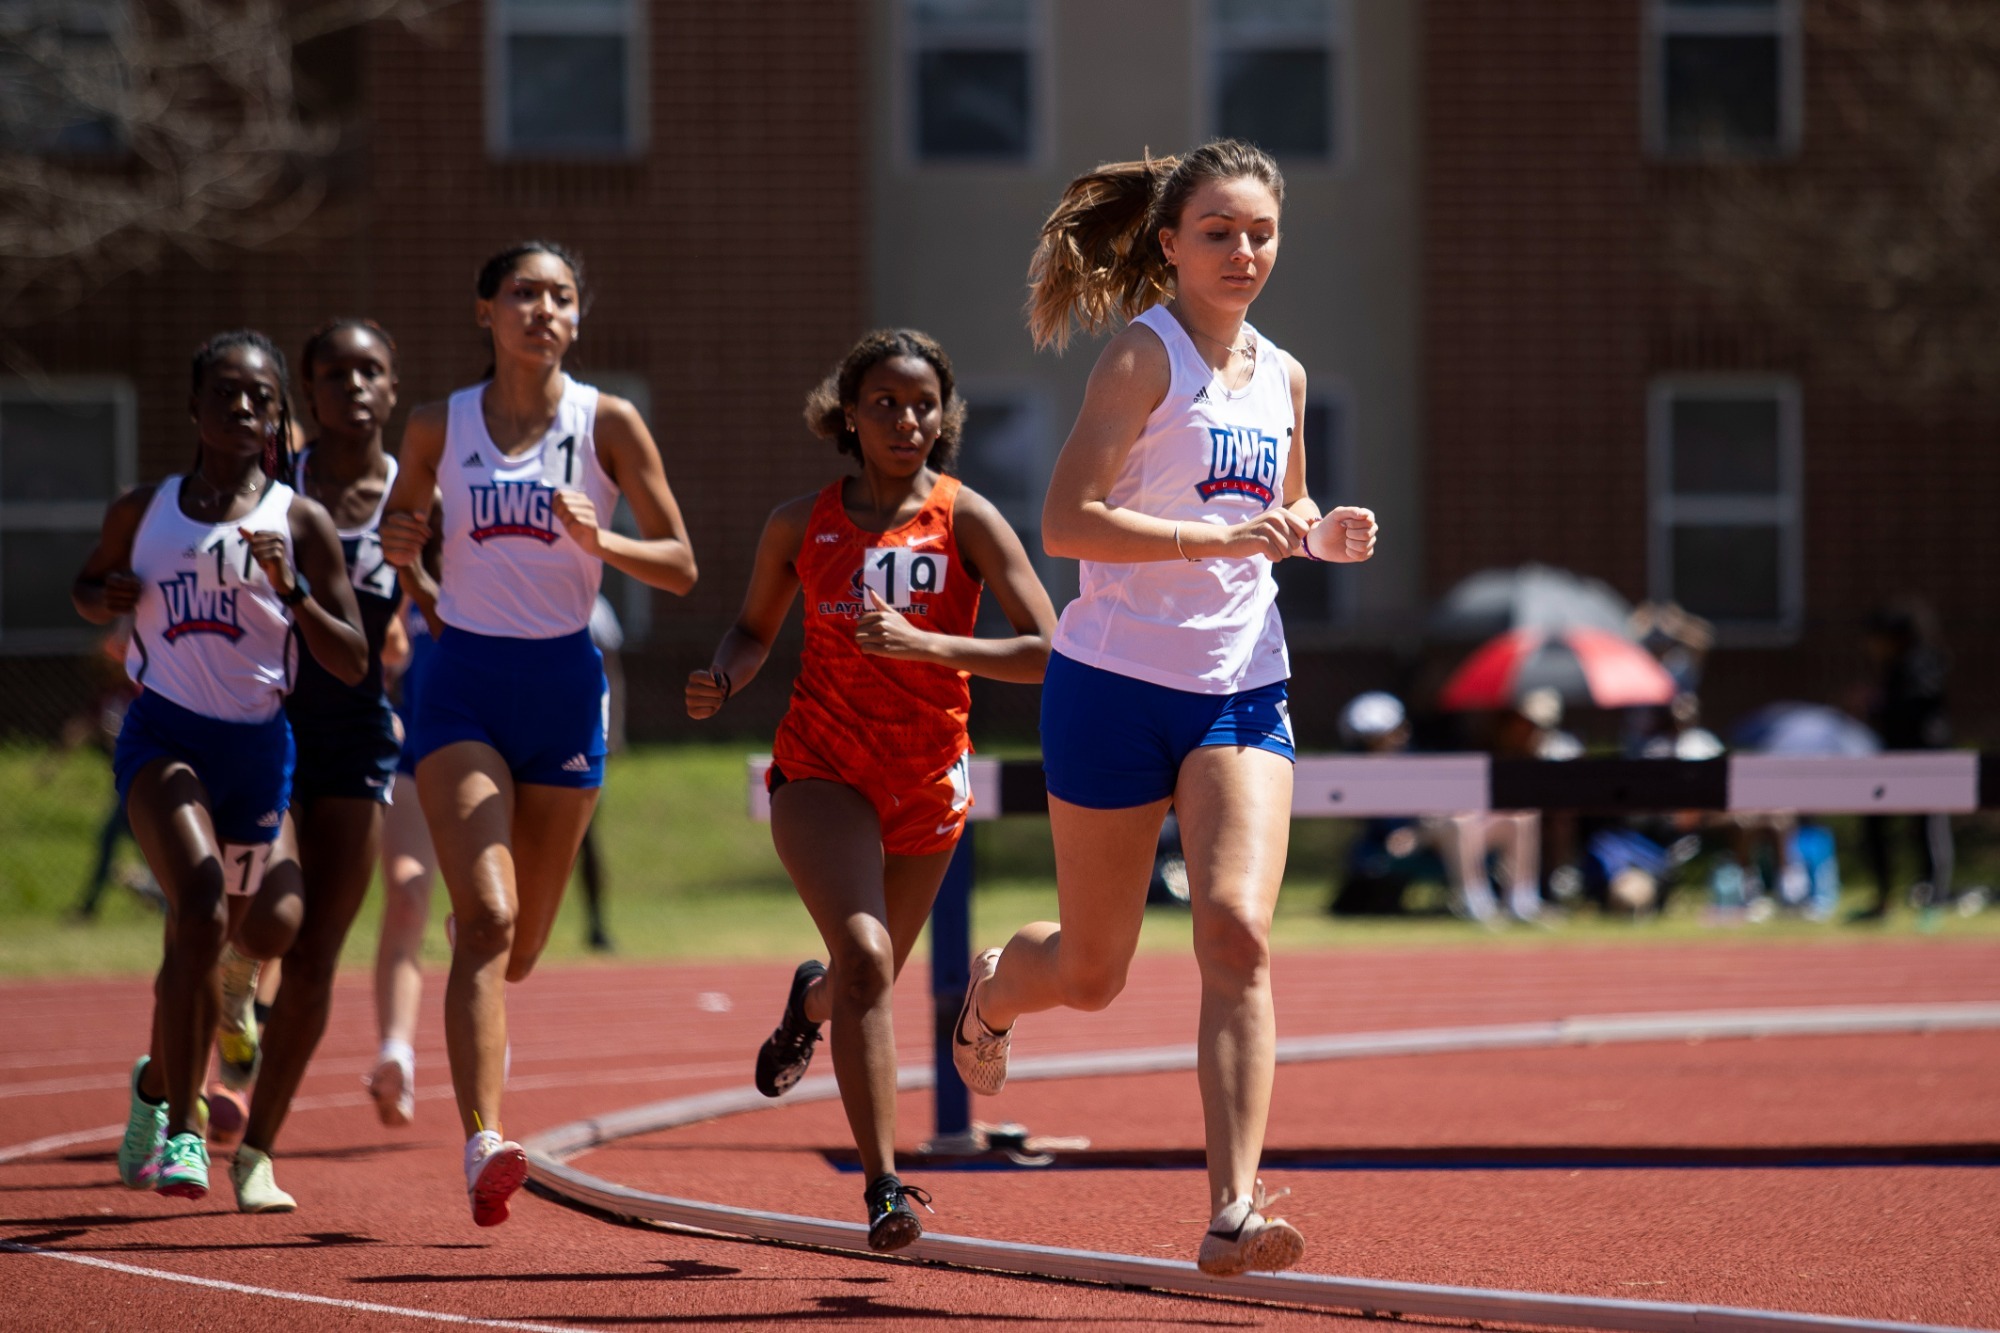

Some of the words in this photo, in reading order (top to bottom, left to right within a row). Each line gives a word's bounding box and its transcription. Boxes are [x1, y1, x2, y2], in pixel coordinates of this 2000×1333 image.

[557, 435, 575, 485] 1
[1208, 423, 1277, 490] UWG
[469, 480, 557, 531] UWG
[1209, 481, 1269, 500] WOLVES
[158, 571, 239, 627] UWG
[235, 850, 253, 892] 1
